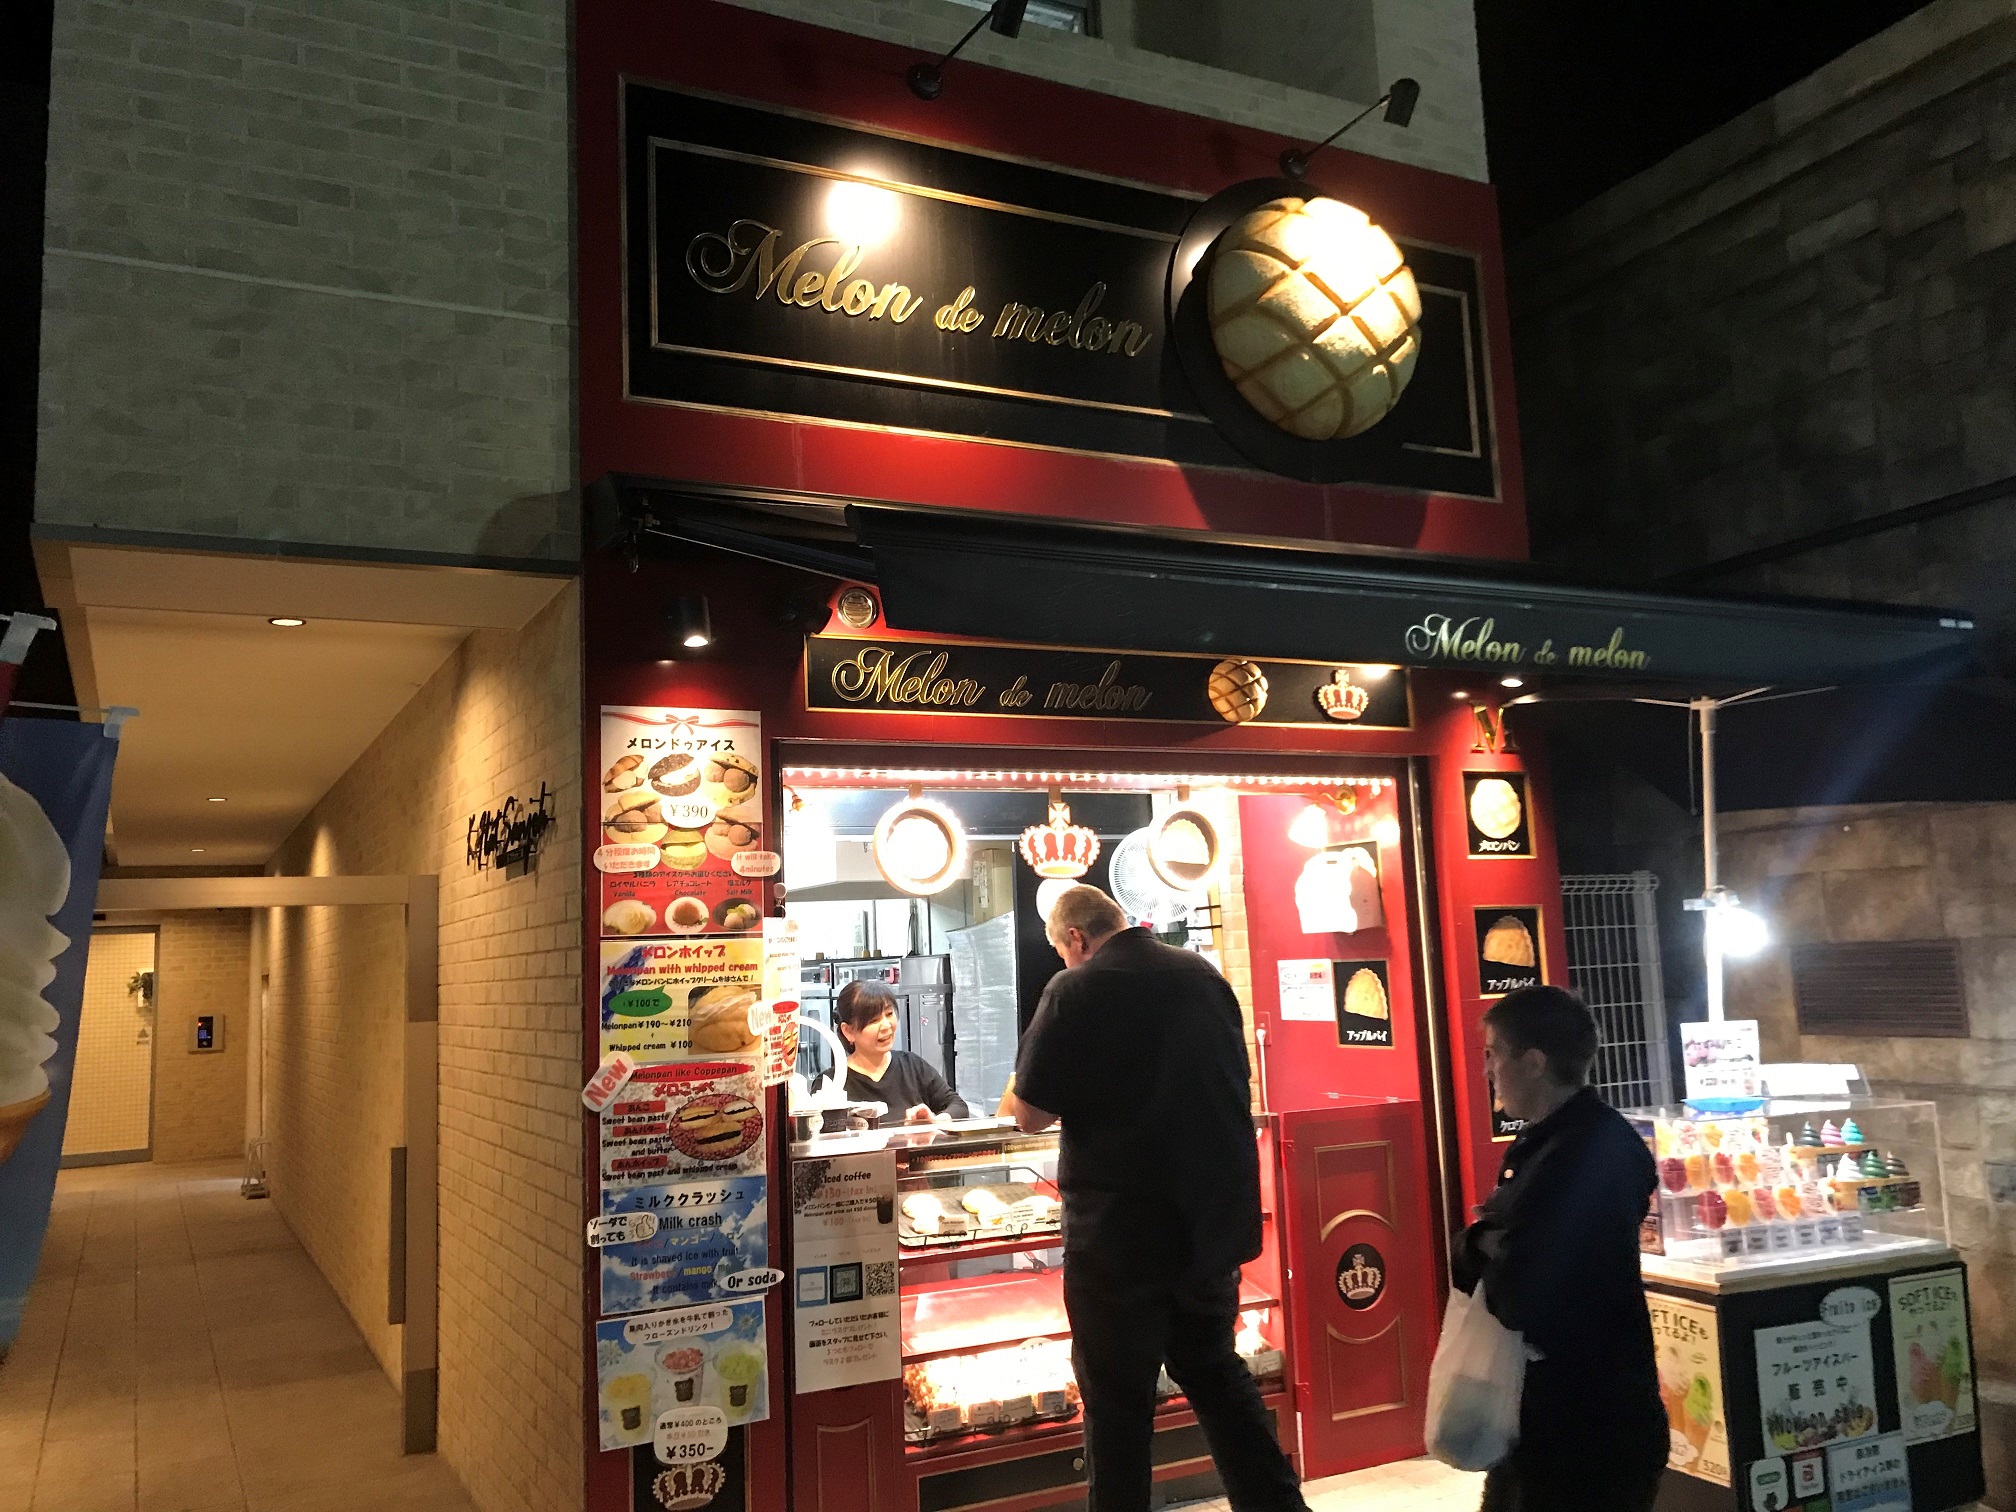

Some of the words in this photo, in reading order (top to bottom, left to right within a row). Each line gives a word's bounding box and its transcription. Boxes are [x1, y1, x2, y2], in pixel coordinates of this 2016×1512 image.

[686, 218, 923, 323] Melon
[934, 285, 984, 332] de
[992, 281, 1153, 357] melon
[1405, 613, 1527, 663] Melon
[1534, 639, 1556, 665] de
[1568, 626, 1650, 670] melon
[832, 646, 986, 706] Melon
[999, 675, 1033, 707] de
[1044, 659, 1153, 711] melon
[626, 737, 735, 751] メロンドゥアイス
[669, 804, 708, 819] ¥390
[736, 853, 742, 861] It
[744, 853, 758, 861] will
[759, 852, 776, 861] take
[614, 890, 636, 898] Vanilla
[674, 889, 706, 897] Chocolate
[641, 945, 726, 959] メロンホイップ
[607, 964, 655, 976] Melonpan
[659, 963, 681, 974] with
[684, 962, 725, 975] whipped
[728, 962, 758, 972] cream
[609, 1043, 641, 1052] Whipped
[643, 1042, 666, 1050] cream
[670, 1040, 693, 1049] ¥100
[631, 1070, 672, 1080] Melonpan
[675, 1068, 691, 1077] like
[694, 1066, 737, 1077] Coppepan
[584, 1058, 628, 1107] New
[602, 1116, 626, 1125] Sweet
[627, 1115, 646, 1124] bean
[648, 1113, 670, 1123] paste
[1499, 1119, 1529, 1133] クロワ
[602, 1137, 627, 1147] Sweet
[628, 1136, 647, 1145] bean
[649, 1135, 671, 1145] paste
[631, 1147, 645, 1156] and
[647, 1145, 672, 1155] butter
[602, 1171, 626, 1181] Sweet
[627, 1170, 645, 1179] bean
[667, 1167, 681, 1175] and
[682, 1164, 713, 1175] whipped
[715, 1162, 738, 1171] cream
[824, 1174, 842, 1184] Iced
[843, 1170, 872, 1182] coffee
[634, 1189, 745, 1209] ミルククラッシュ
[589, 1215, 628, 1230] ソーダで
[659, 1216, 684, 1230] Milk
[688, 1212, 722, 1228] crash
[589, 1231, 626, 1245] 割っても
[640, 1256, 648, 1266] is
[651, 1252, 683, 1264] shaved
[685, 1250, 699, 1261] ice
[702, 1247, 720, 1258] with
[683, 1265, 713, 1277] mango
[662, 1280, 699, 1293] contains
[727, 1275, 743, 1289] Or
[747, 1270, 777, 1286] soda
[1898, 1286, 1929, 1307] SOFT
[1653, 1326, 1696, 1345] ってるよ!
[666, 1442, 714, 1460] ¥350-
